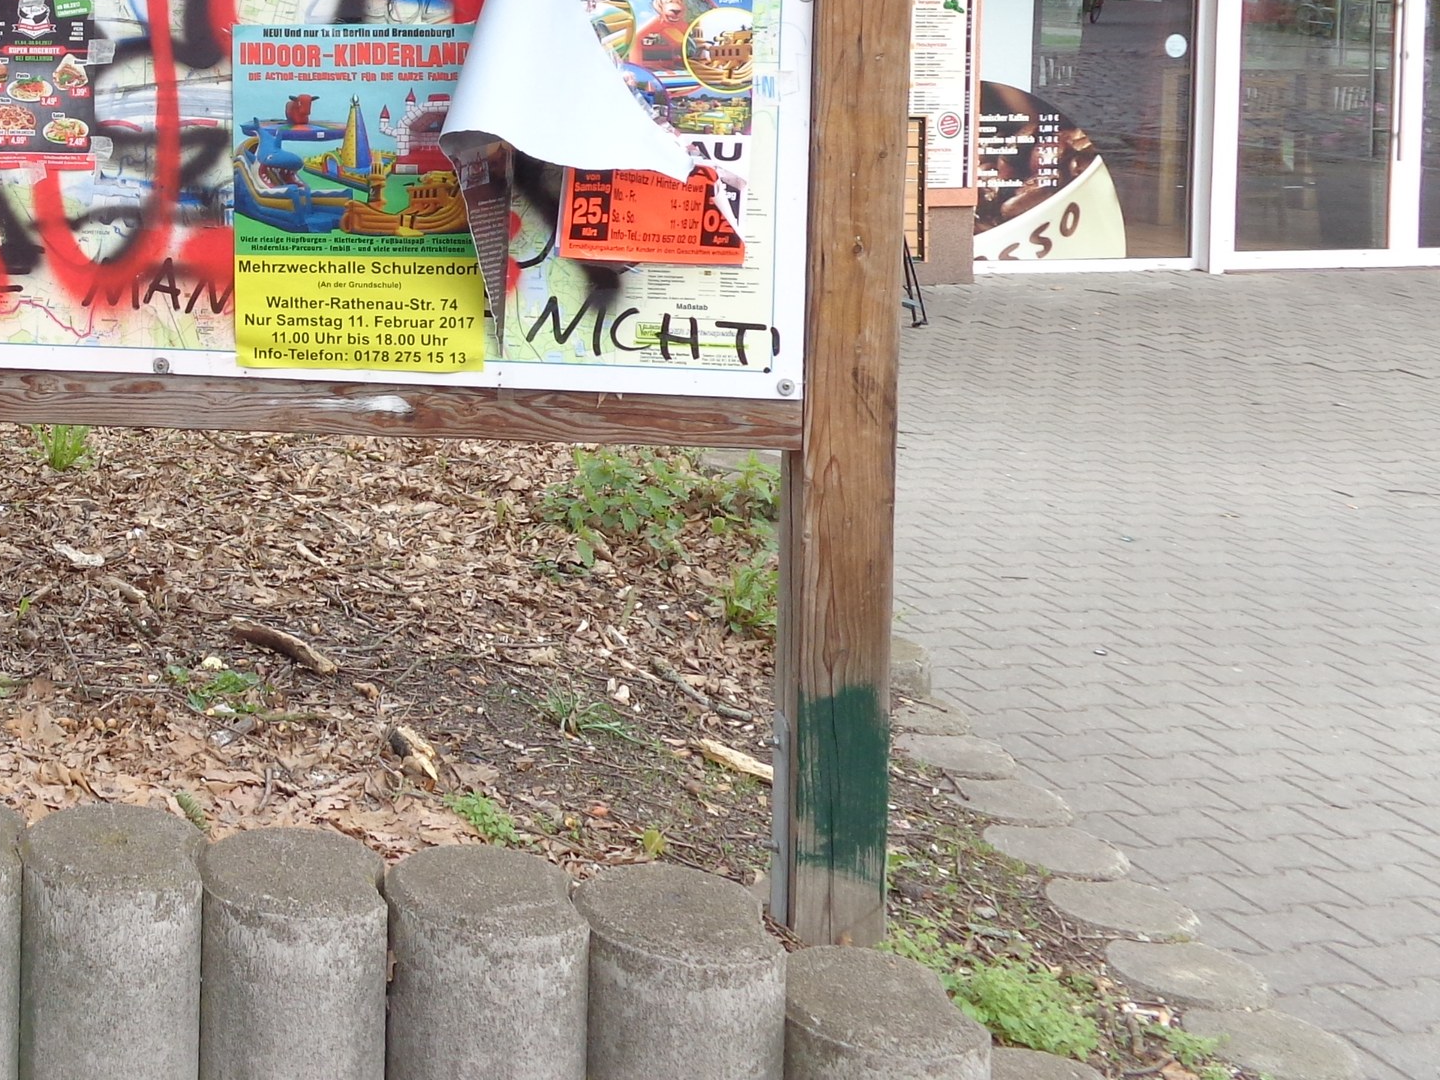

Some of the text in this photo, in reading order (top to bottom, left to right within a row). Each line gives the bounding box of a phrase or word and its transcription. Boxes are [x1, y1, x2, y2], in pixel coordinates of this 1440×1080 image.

[263, 28, 455, 38] NEU! Und nur 1x in Berlin und Brandenburg!
[249, 72, 260, 80] DIE
[361, 72, 376, 81] FÜR
[381, 72, 393, 80] DIE
[398, 72, 423, 80] GANZE
[428, 72, 458, 80] FAMILIE
[615, 171, 648, 185] Festplatz
[575, 182, 610, 193] Samstag
[573, 198, 608, 224] 25.
[691, 200, 701, 211] Uhr
[689, 220, 699, 230] Uhr
[643, 233, 660, 241] 0173
[663, 234, 675, 242] 657
[678, 235, 687, 243] 02
[688, 235, 696, 244] 03
[712, 236, 729, 244] April
[677, 248, 710, 256] Geschäften
[239, 260, 478, 275] Mehrzweckhalle Schulzendorf
[318, 280, 330, 289] (An
[349, 281, 401, 290] Grundschule)
[266, 297, 457, 311] Walther-Rathenau-Str. 74
[245, 314, 474, 329] Nur Samstag 11. Februar 2017
[272, 332, 448, 346] 11.00 Uhr bis 18.00 Uhr
[254, 347, 465, 364] Info-Telefon: 0178 275 15 13
